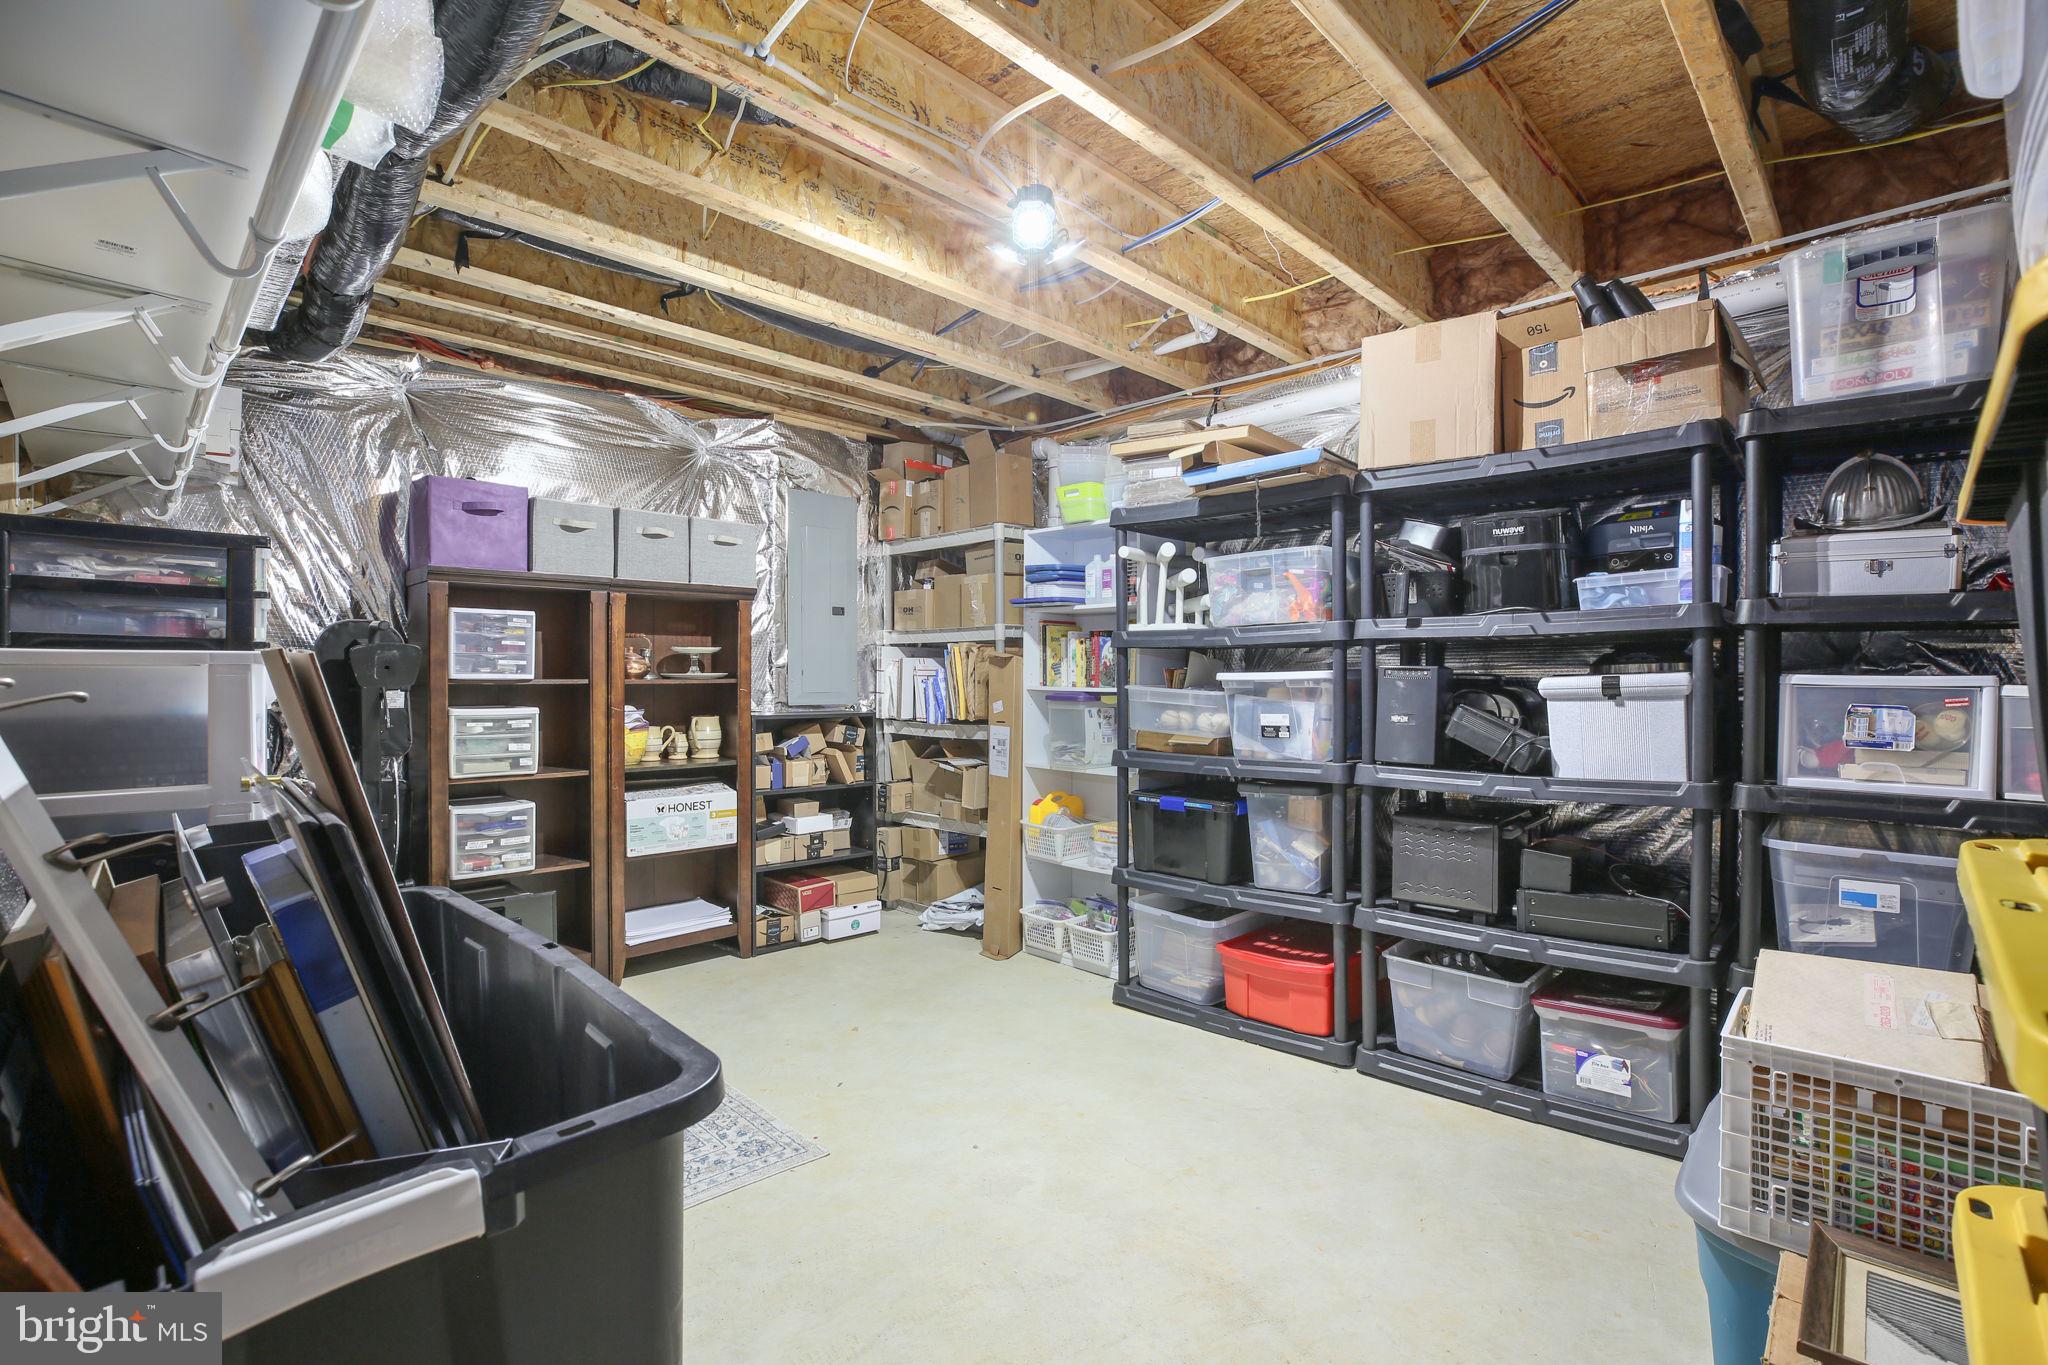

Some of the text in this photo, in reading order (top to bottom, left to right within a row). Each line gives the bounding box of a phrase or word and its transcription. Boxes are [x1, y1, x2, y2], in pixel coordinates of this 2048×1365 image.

[1527, 322, 1550, 337] 150
[1833, 368, 1911, 390] MONOPOLY
[1538, 428, 1561, 438] prime
[1492, 525, 1525, 535] nuwave
[1630, 525, 1654, 534] NINJA
[668, 800, 712, 813] HONEST
